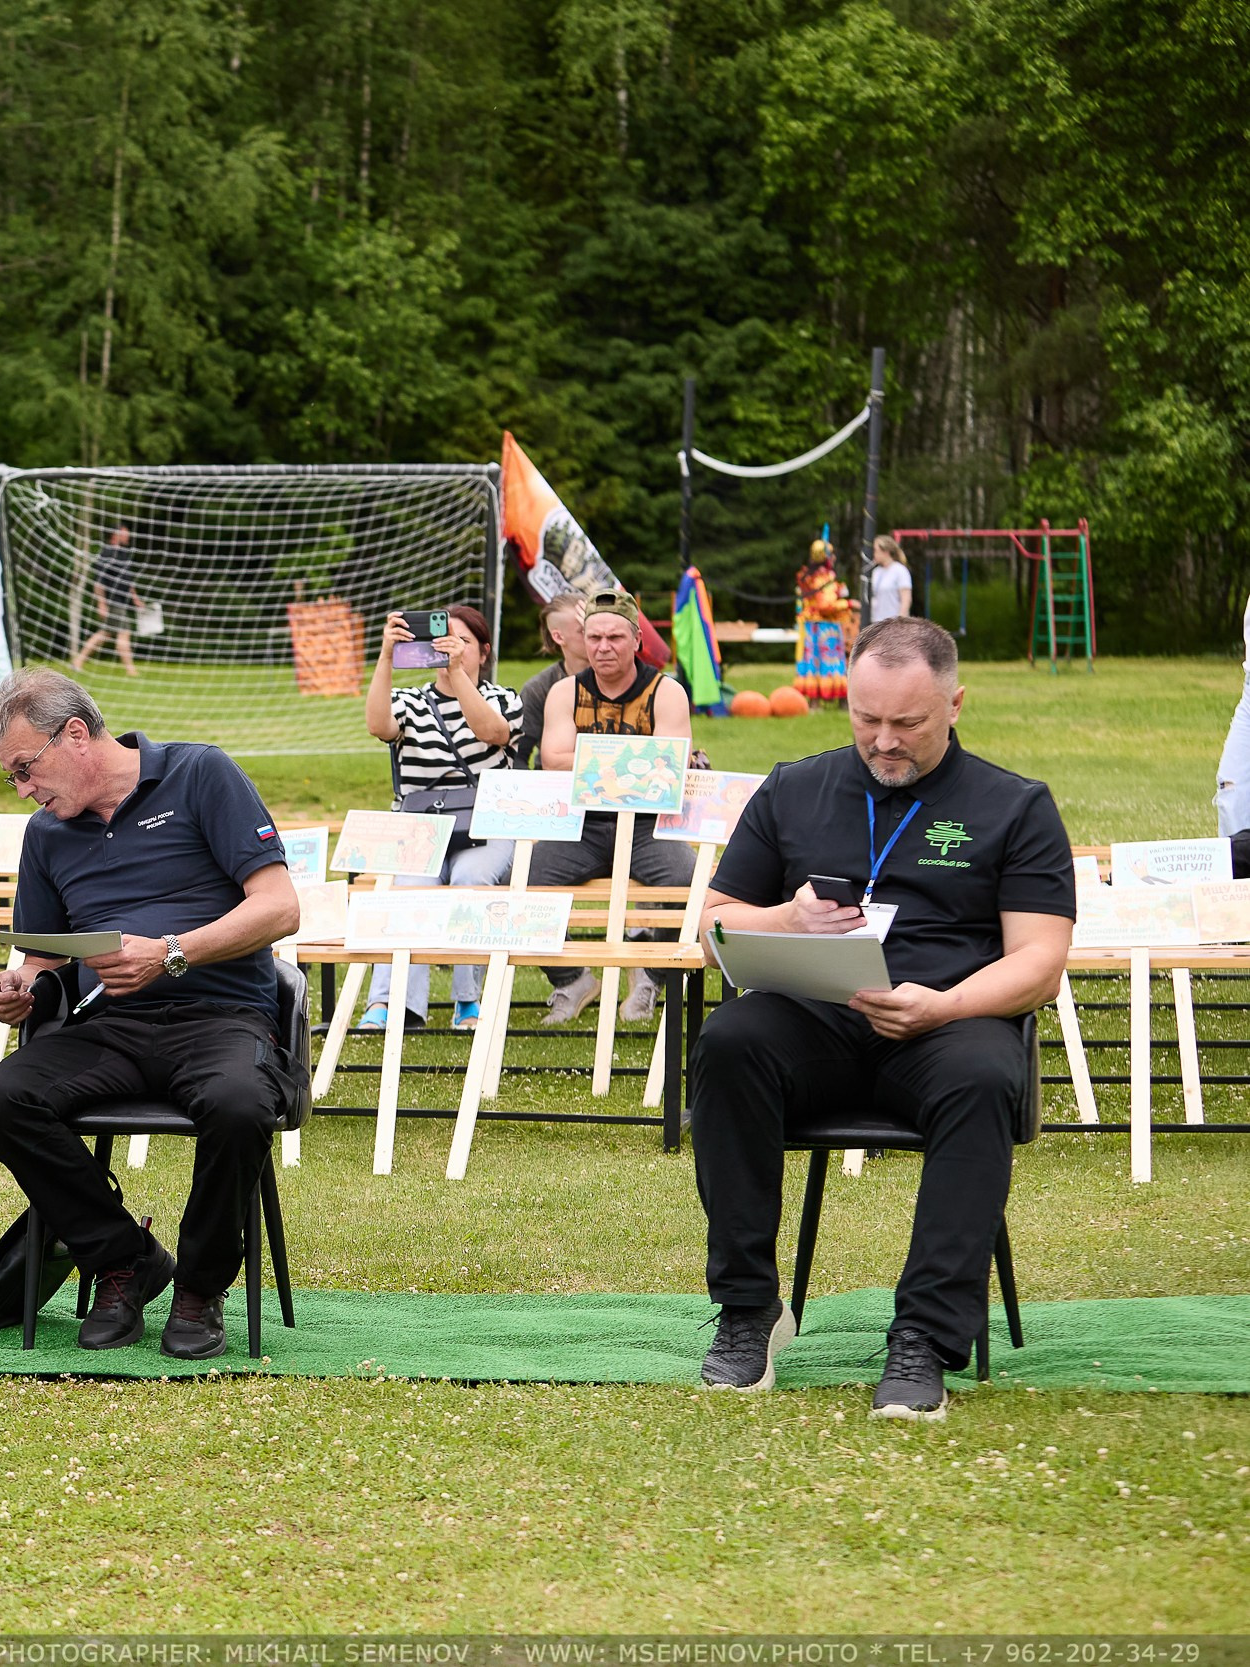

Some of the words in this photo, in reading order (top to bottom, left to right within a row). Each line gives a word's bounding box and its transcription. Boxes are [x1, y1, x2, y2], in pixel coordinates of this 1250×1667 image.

[918, 858, 956, 867] СОСНОВЫЙ
[1154, 853, 1213, 864] ПОТЯНУЛО
[1167, 862, 1213, 873] ЗАГУЛ!
[1201, 885, 1231, 896] ИЩУ
[1211, 895, 1219, 903] В
[524, 904, 557, 913] РЯДОМ
[460, 934, 523, 946] ВИТАМЫН
